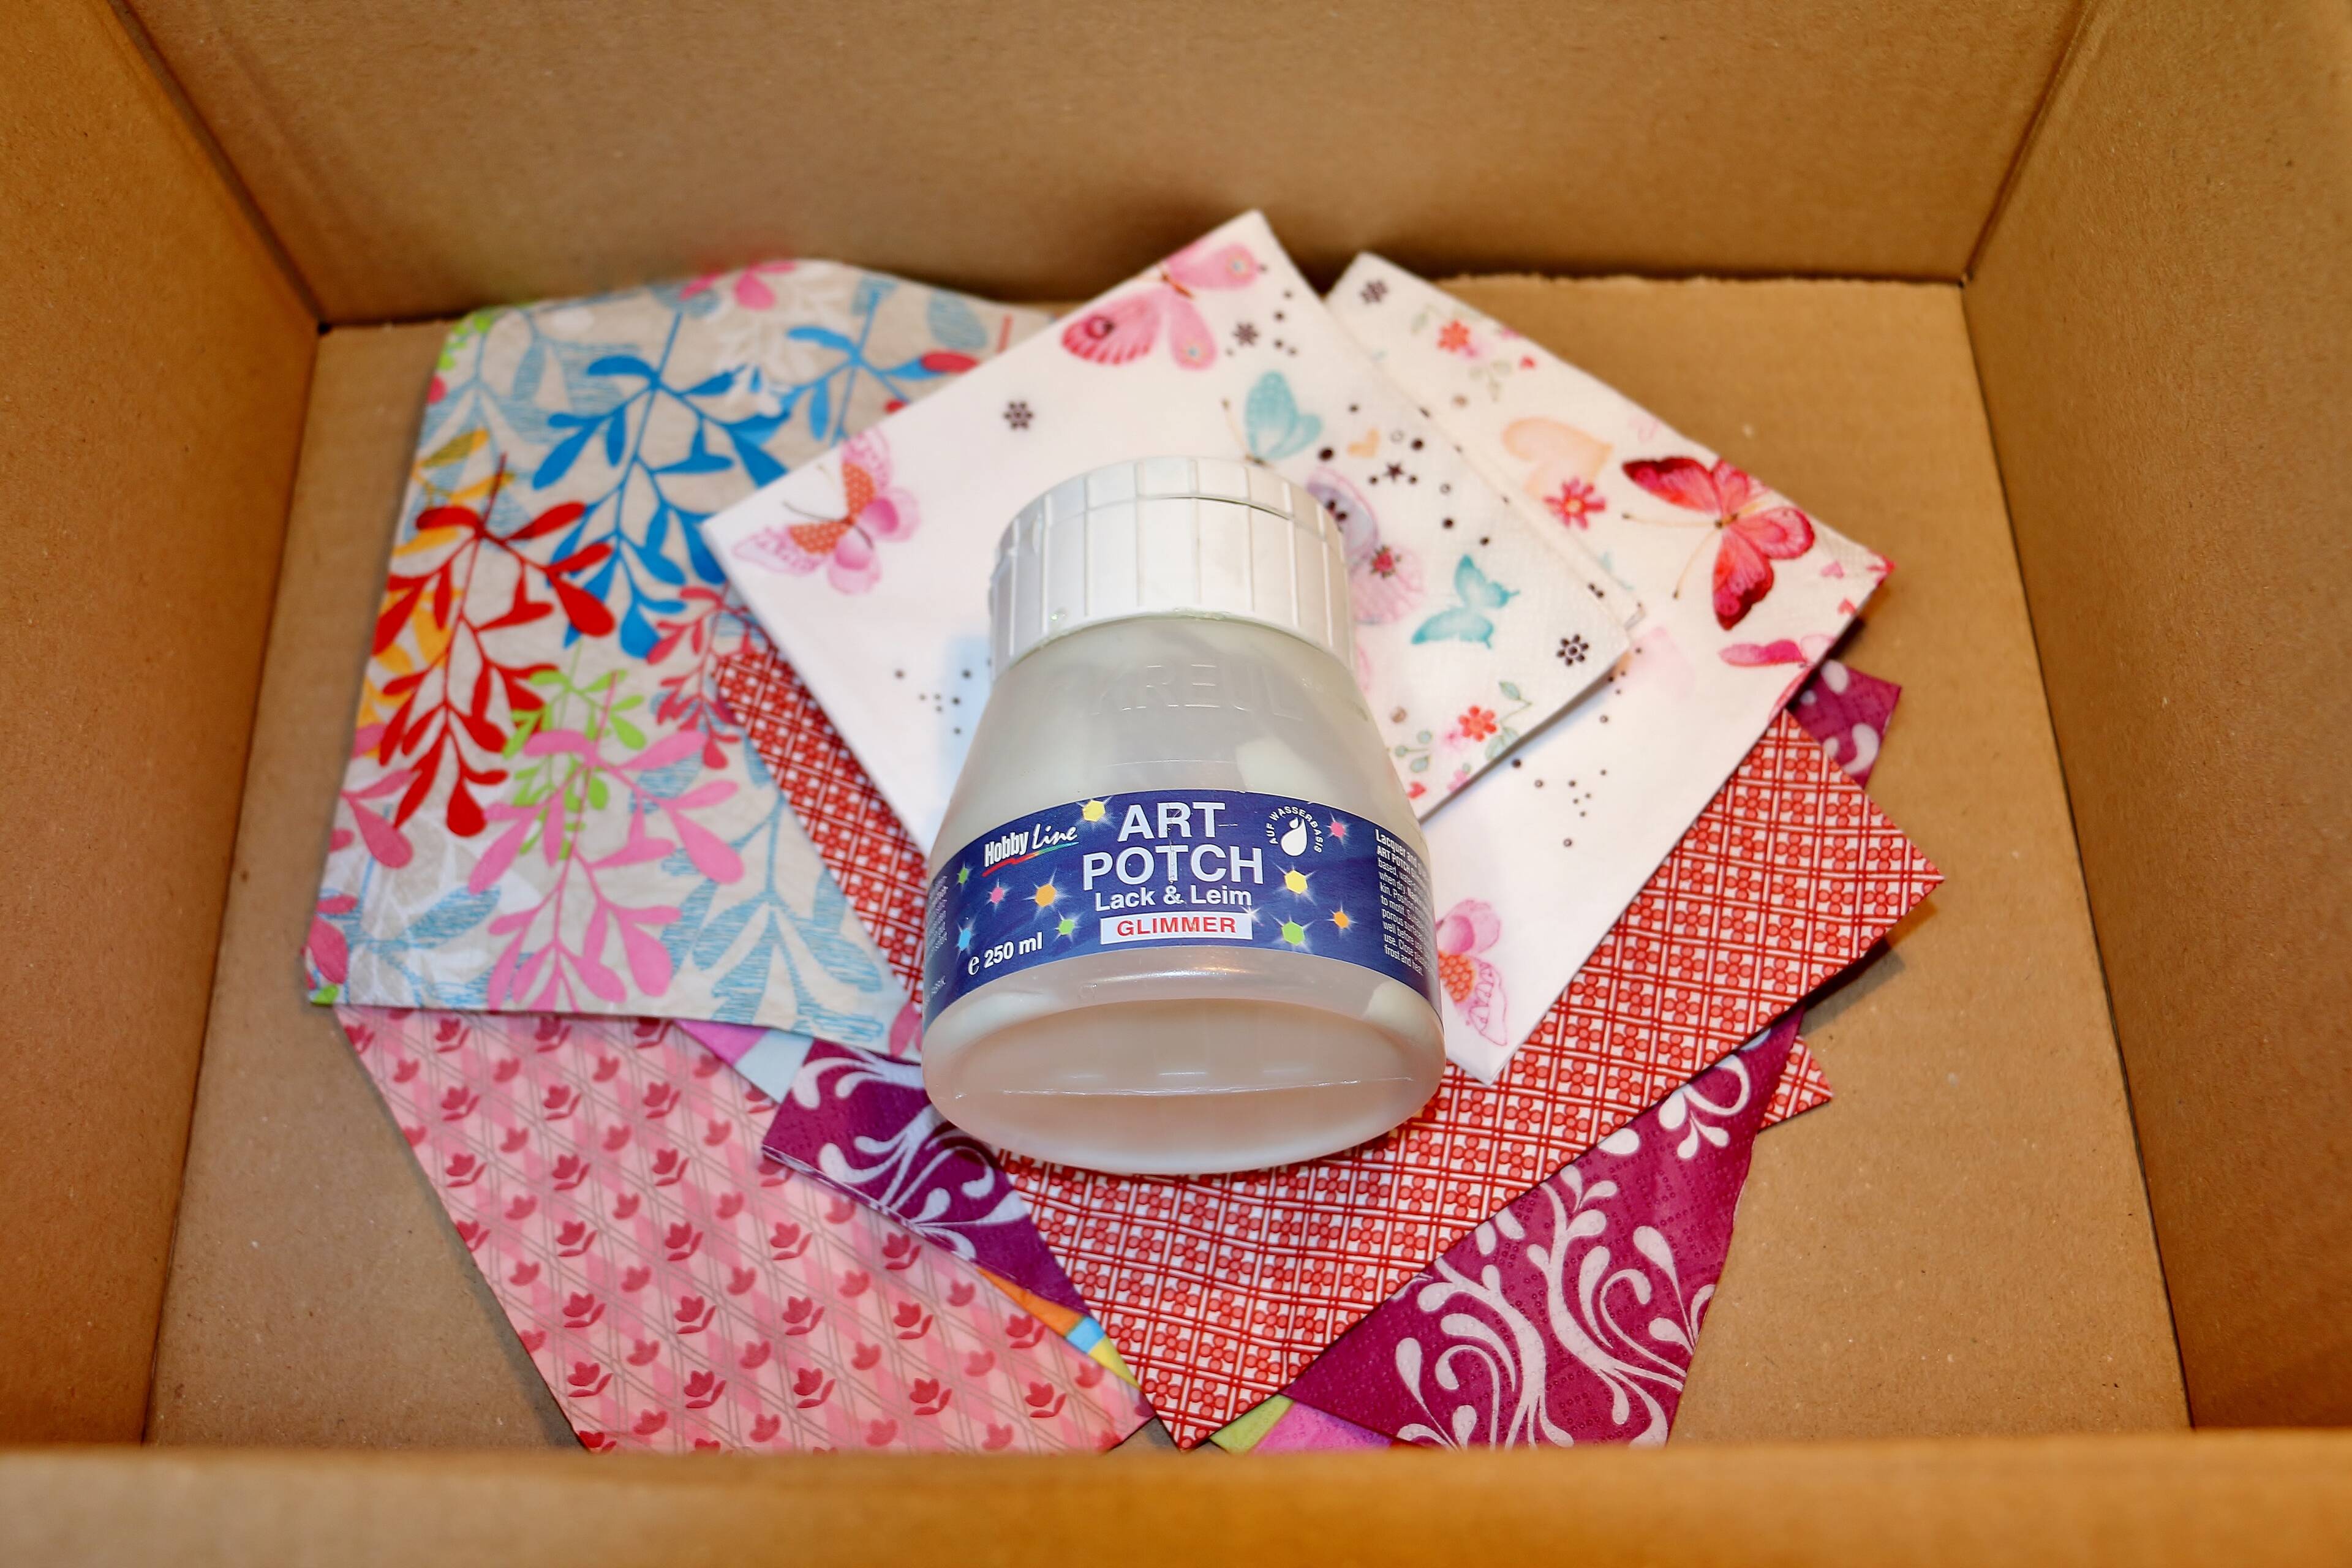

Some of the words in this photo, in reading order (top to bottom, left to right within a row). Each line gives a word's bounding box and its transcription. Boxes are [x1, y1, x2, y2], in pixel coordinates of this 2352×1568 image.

[1118, 802, 1226, 842] ART
[1265, 823, 1278, 844] AUF
[1269, 806, 1324, 853] WASSERBASIS
[984, 831, 1028, 867] Hobby
[1032, 823, 1077, 849] Line
[1375, 828, 1406, 858] Lacquer
[1083, 845, 1264, 891] POTCH
[1377, 845, 1390, 860] ART
[1392, 854, 1410, 873] POTCH
[1378, 858, 1398, 878] based,
[1379, 871, 1396, 886] when
[1380, 882, 1392, 897] kin.
[1095, 888, 1155, 911] Lack
[1163, 885, 1183, 905] &
[1191, 884, 1252, 906] Leim
[1381, 895, 1389, 906] to
[1117, 916, 1236, 937] GLIMMER
[1382, 908, 1404, 927] porous
[1382, 921, 1396, 935] well
[1397, 926, 1414, 946] before
[1384, 933, 1397, 947] use.
[1398, 938, 1414, 957] Close
[984, 941, 1014, 968] 250
[1019, 932, 1042, 955] ml
[1384, 944, 1401, 962] frost
[1401, 953, 1411, 967] and
